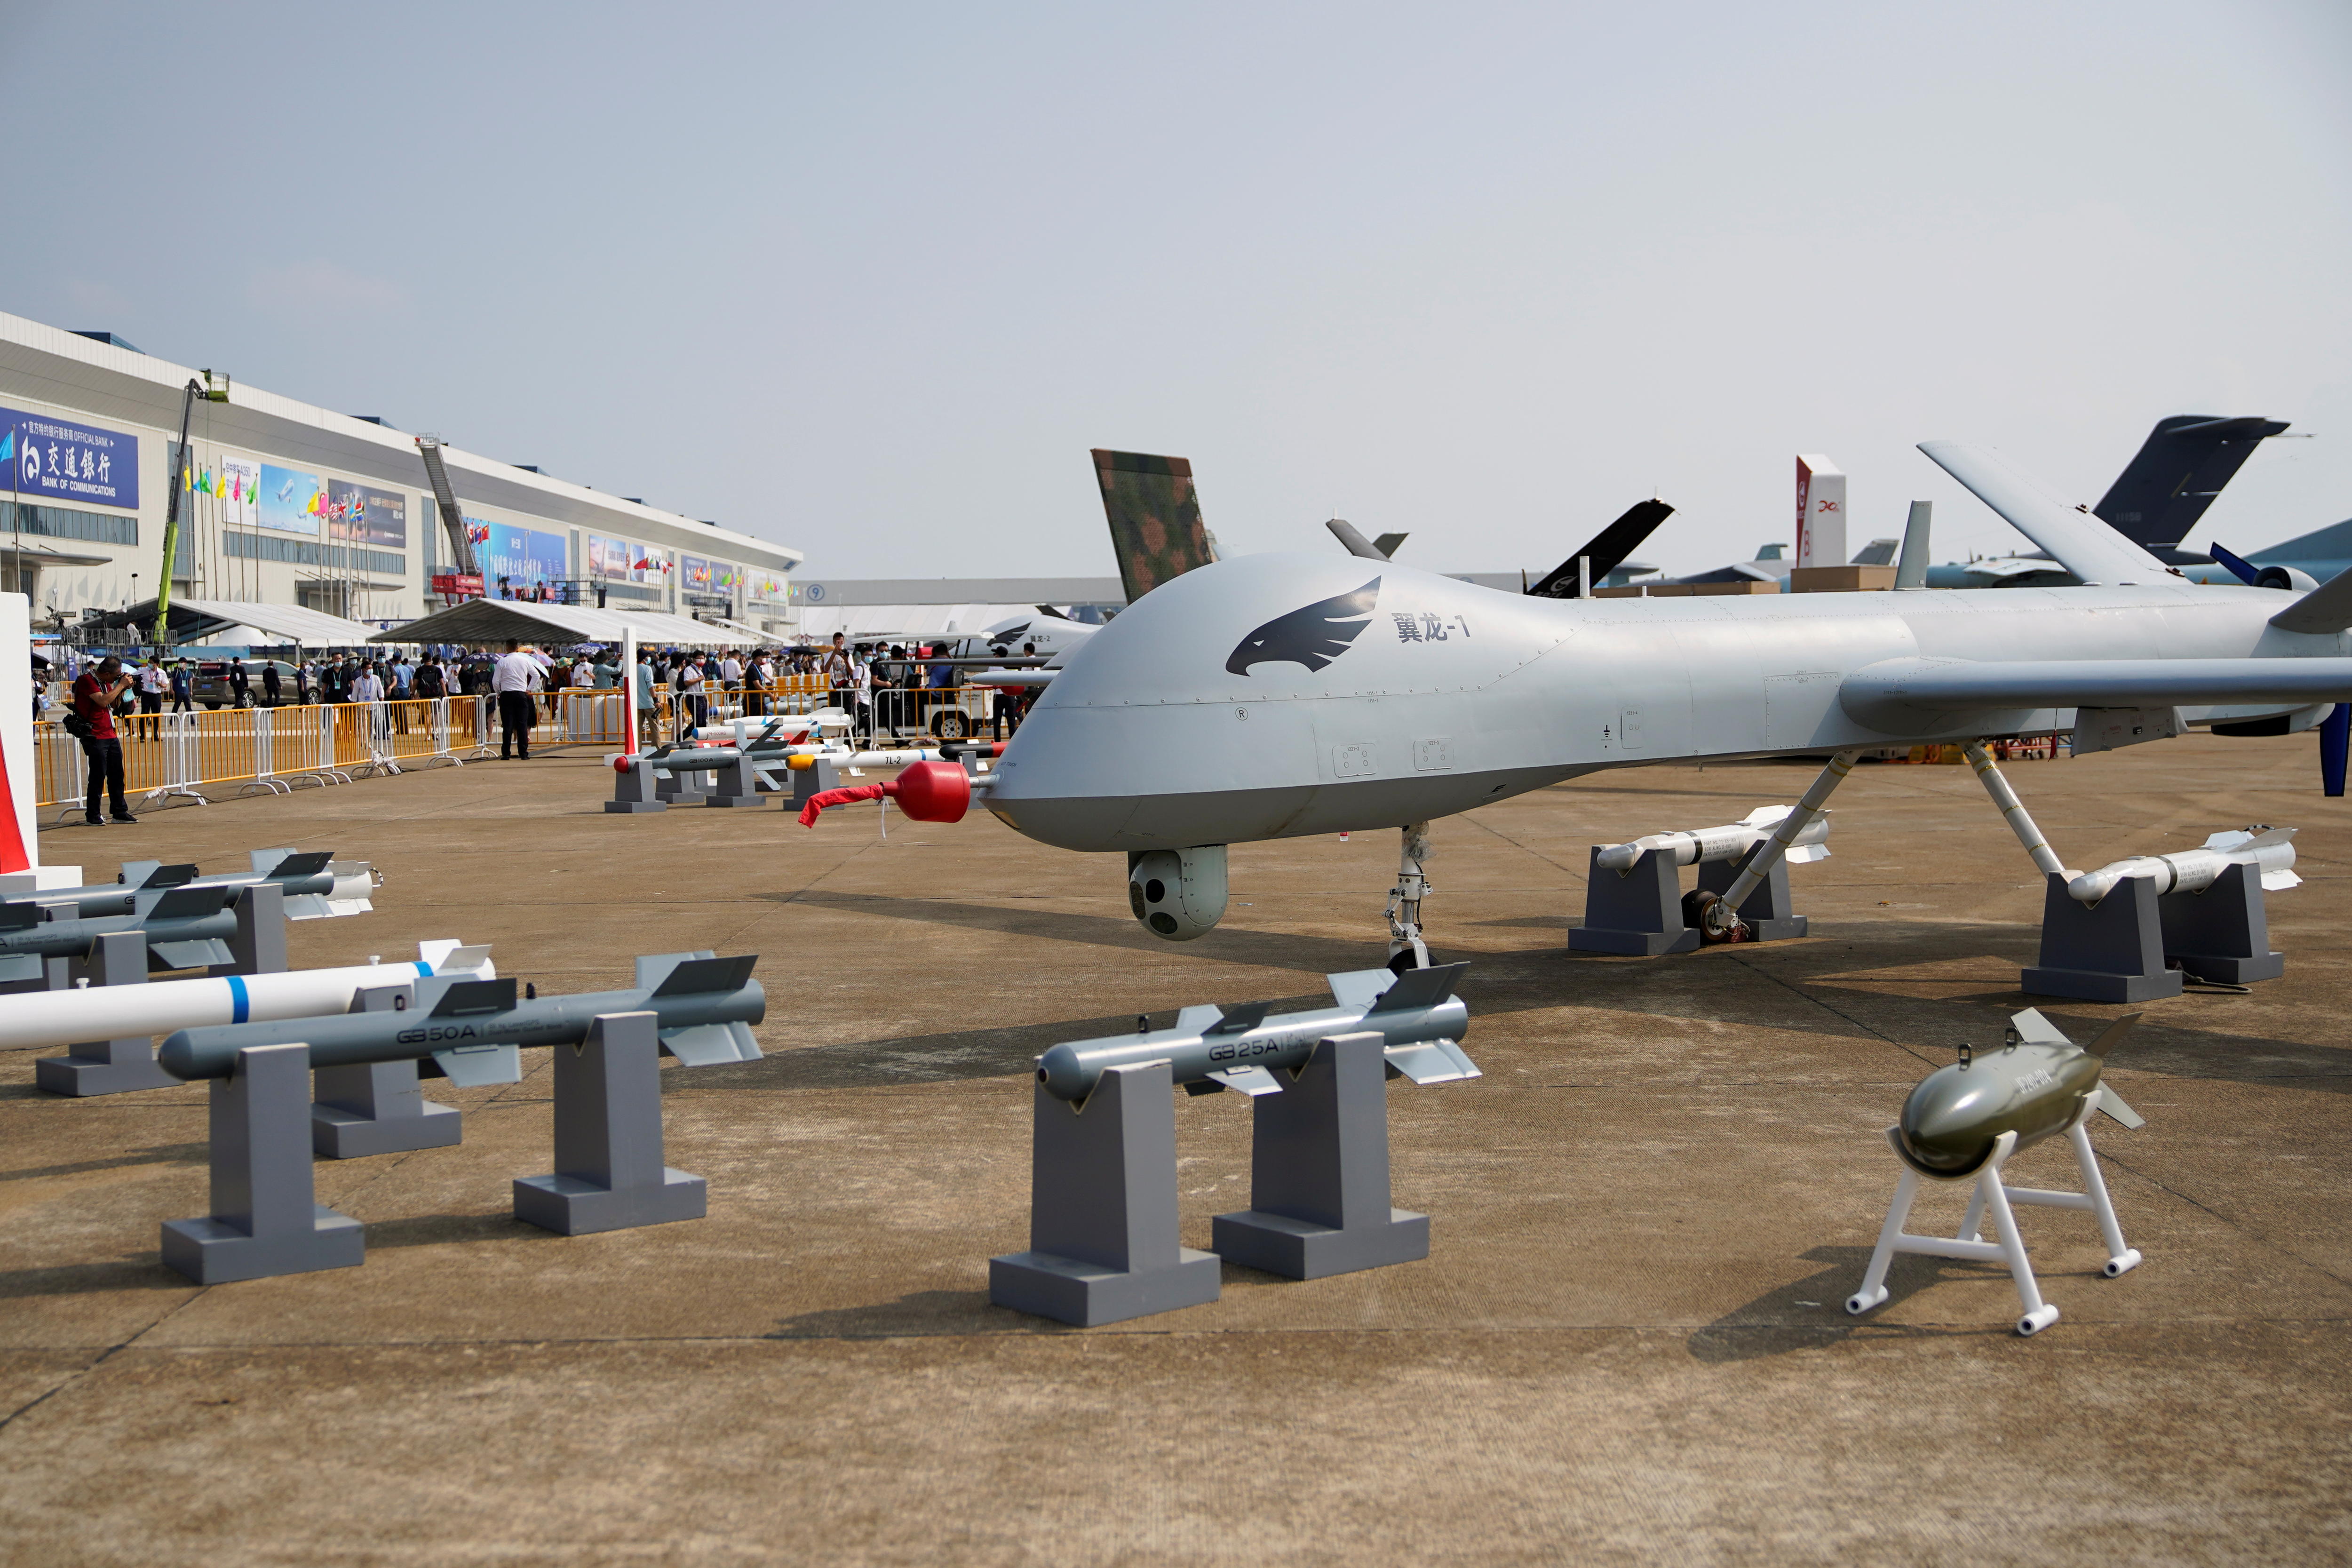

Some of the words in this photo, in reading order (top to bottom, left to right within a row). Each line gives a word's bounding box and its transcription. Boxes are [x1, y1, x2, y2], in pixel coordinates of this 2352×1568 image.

[29, 421, 73, 441] 官方特约银行服务商
[74, 431, 95, 445] OFFICIAL
[95, 436, 108, 447] BANK
[48, 441, 111, 483] 交通銀行
[42, 476, 58, 488] BANK
[60, 479, 68, 489] OF
[70, 480, 116, 497] COMMUNICATIONS
[1804, 530, 1810, 557] B
[1391, 612, 1470, 644] 翼龙-1
[885, 756, 901, 764] TL-2
[397, 1025, 476, 1043] GB50A
[1209, 1038, 1279, 1061] GB25A
